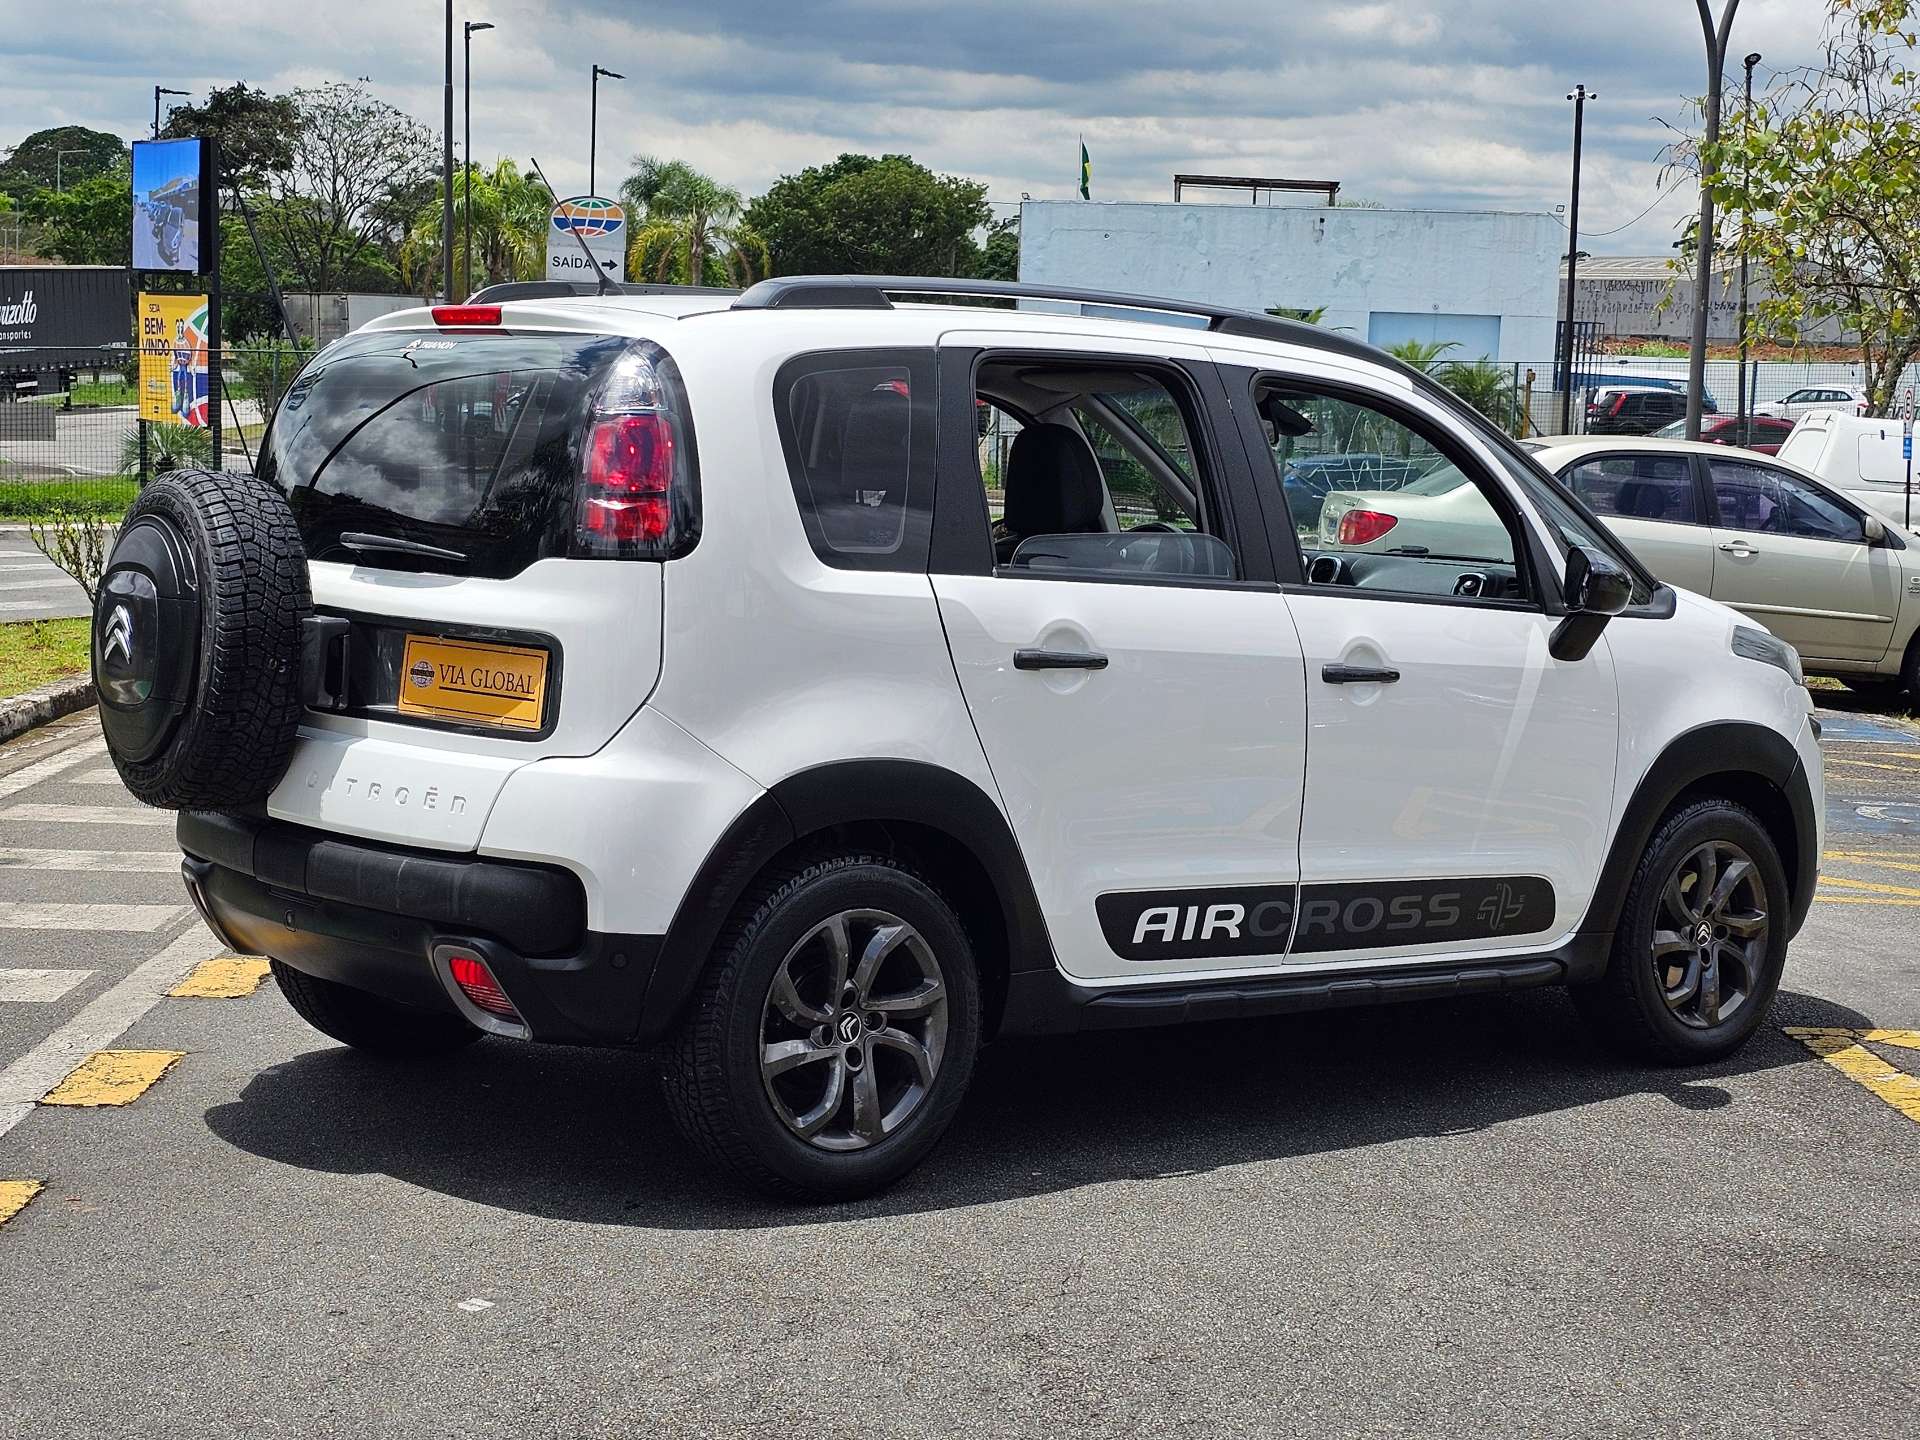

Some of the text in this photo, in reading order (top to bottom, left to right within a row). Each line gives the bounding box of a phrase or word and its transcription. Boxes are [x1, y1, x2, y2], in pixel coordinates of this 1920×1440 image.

[552, 254, 593, 269] SAÍDA
[0, 290, 37, 325] rizotto
[144, 317, 167, 335] BEM-
[141, 338, 170, 356] VINDO
[439, 663, 536, 695] VIA GLOBAL
